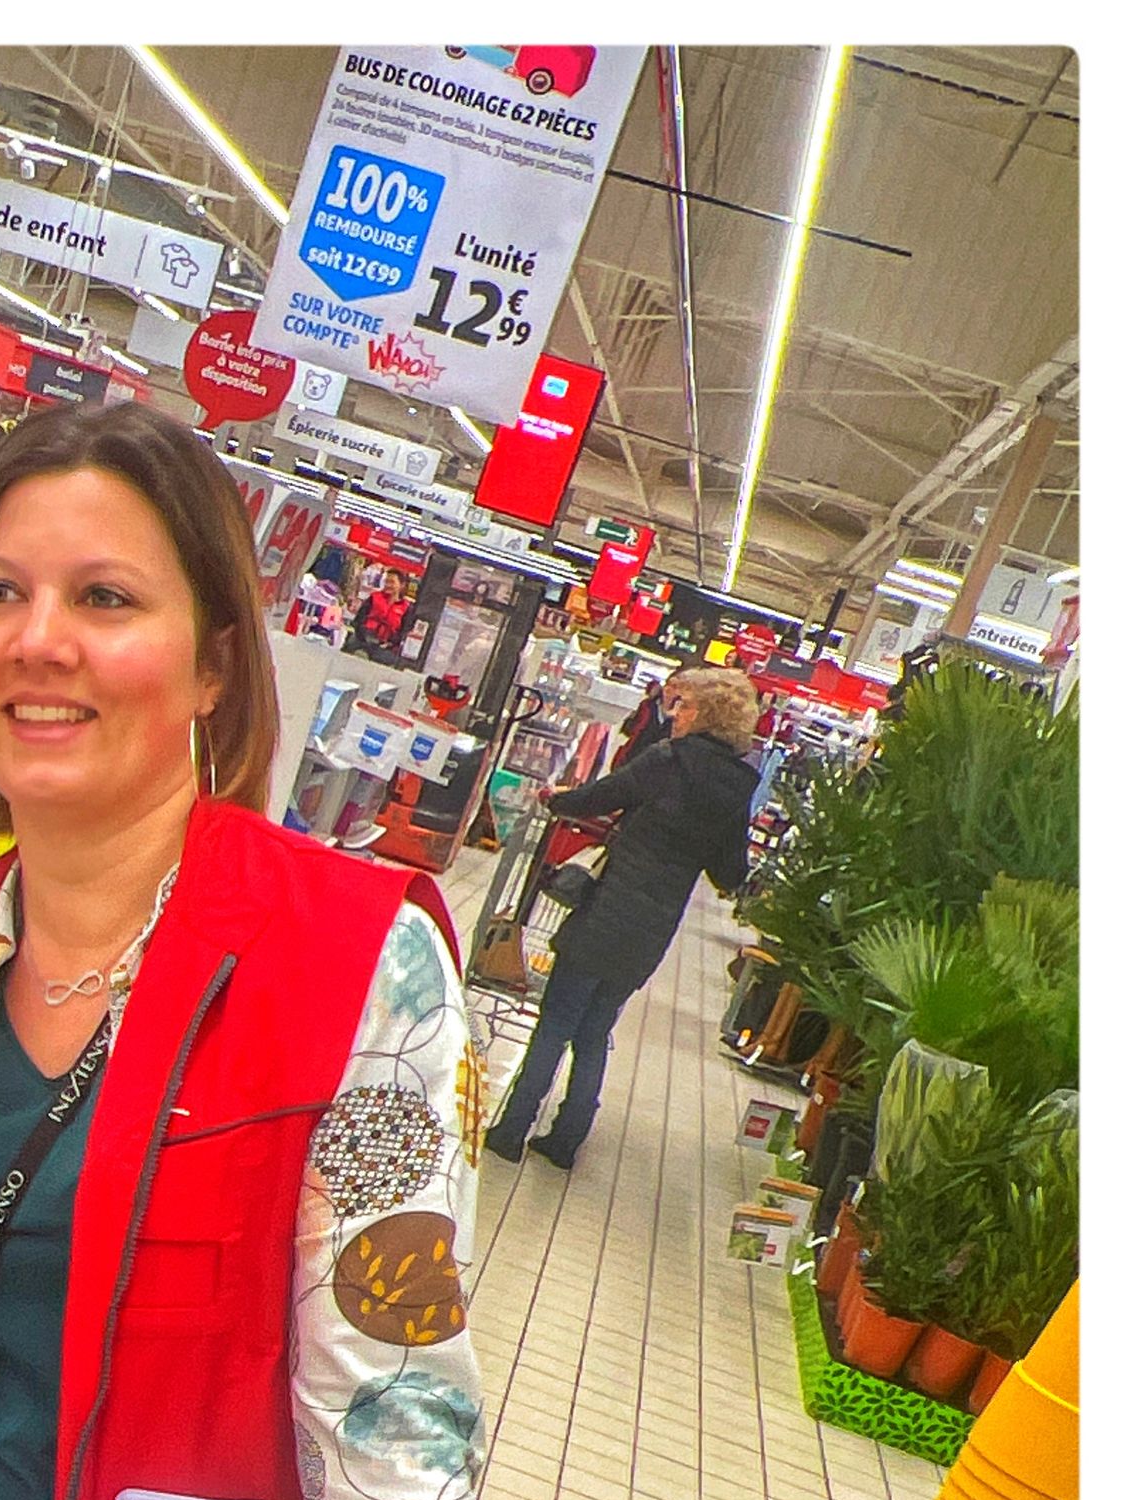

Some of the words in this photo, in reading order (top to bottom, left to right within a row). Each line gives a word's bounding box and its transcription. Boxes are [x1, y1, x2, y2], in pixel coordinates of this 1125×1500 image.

[345, 54, 381, 80] BUS
[383, 62, 408, 87] DE
[408, 69, 511, 118] COLORIAGE
[511, 103, 535, 125] 62
[535, 107, 598, 141] PIÈCES
[326, 156, 428, 223] 100%
[27, 220, 108, 257] enfant
[314, 211, 418, 256] REMBOURSÉ
[455, 232, 537, 277] L'unité
[307, 247, 343, 270] soit
[342, 253, 401, 287] 12€99
[289, 292, 323, 316] SUR
[327, 303, 384, 335] VOTRE
[414, 266, 502, 348] 12
[496, 317, 531, 346] 99
[287, 414, 340, 444] Épicerie
[341, 437, 384, 458] sucrée
